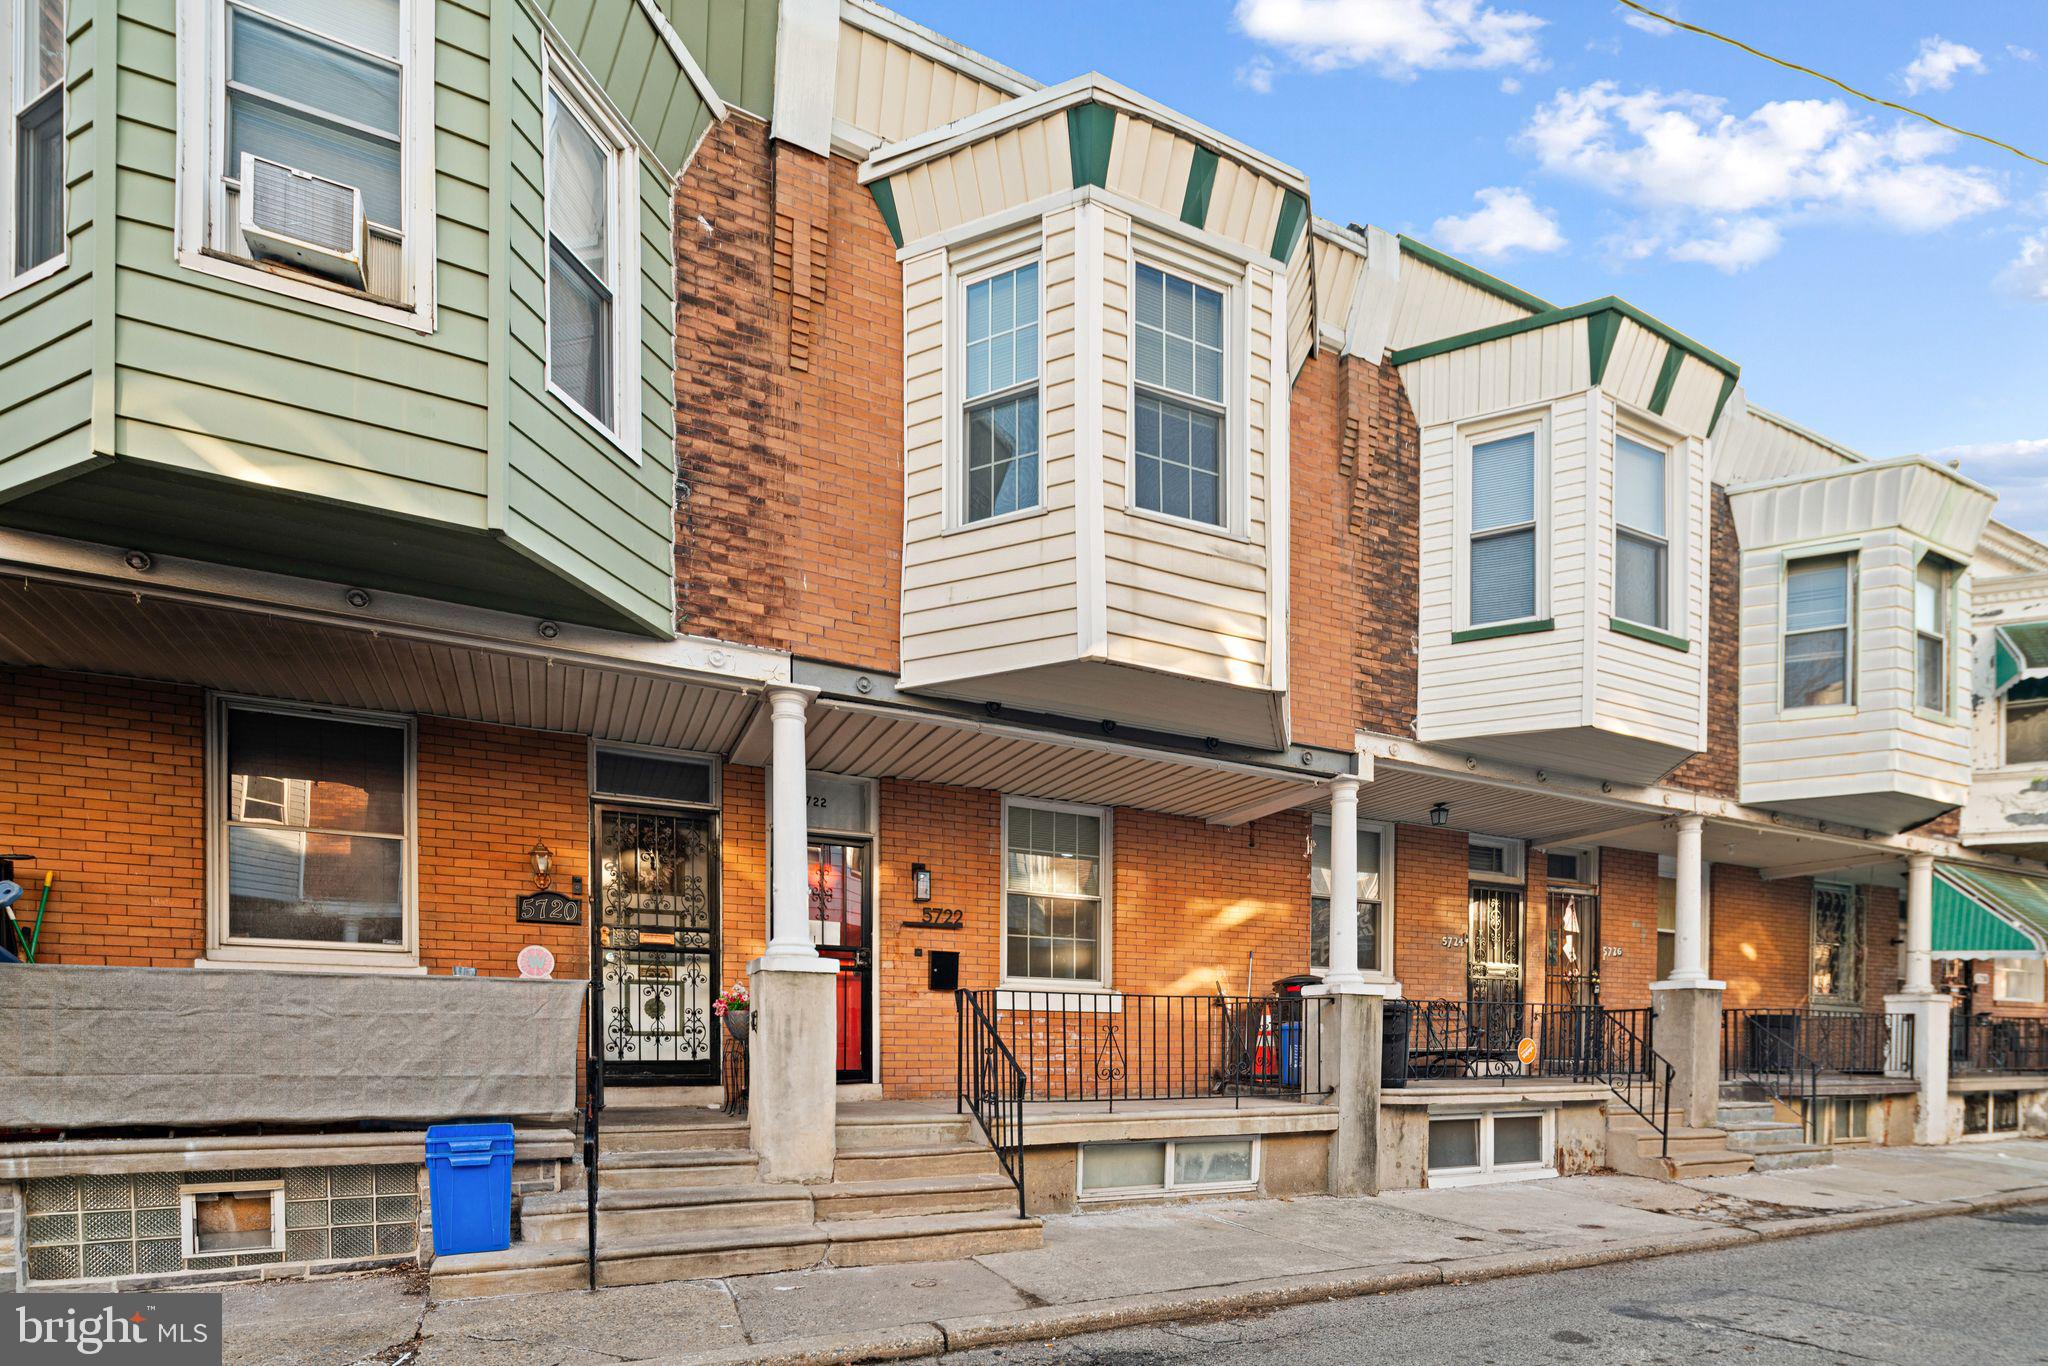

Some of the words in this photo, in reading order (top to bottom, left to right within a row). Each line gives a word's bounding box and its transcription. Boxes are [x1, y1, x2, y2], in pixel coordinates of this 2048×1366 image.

[806, 795, 827, 808] 722
[521, 898, 578, 921] 5720
[922, 906, 963, 926] 5722
[1442, 936, 1465, 949] 5724
[1602, 946, 1623, 957] 5726
